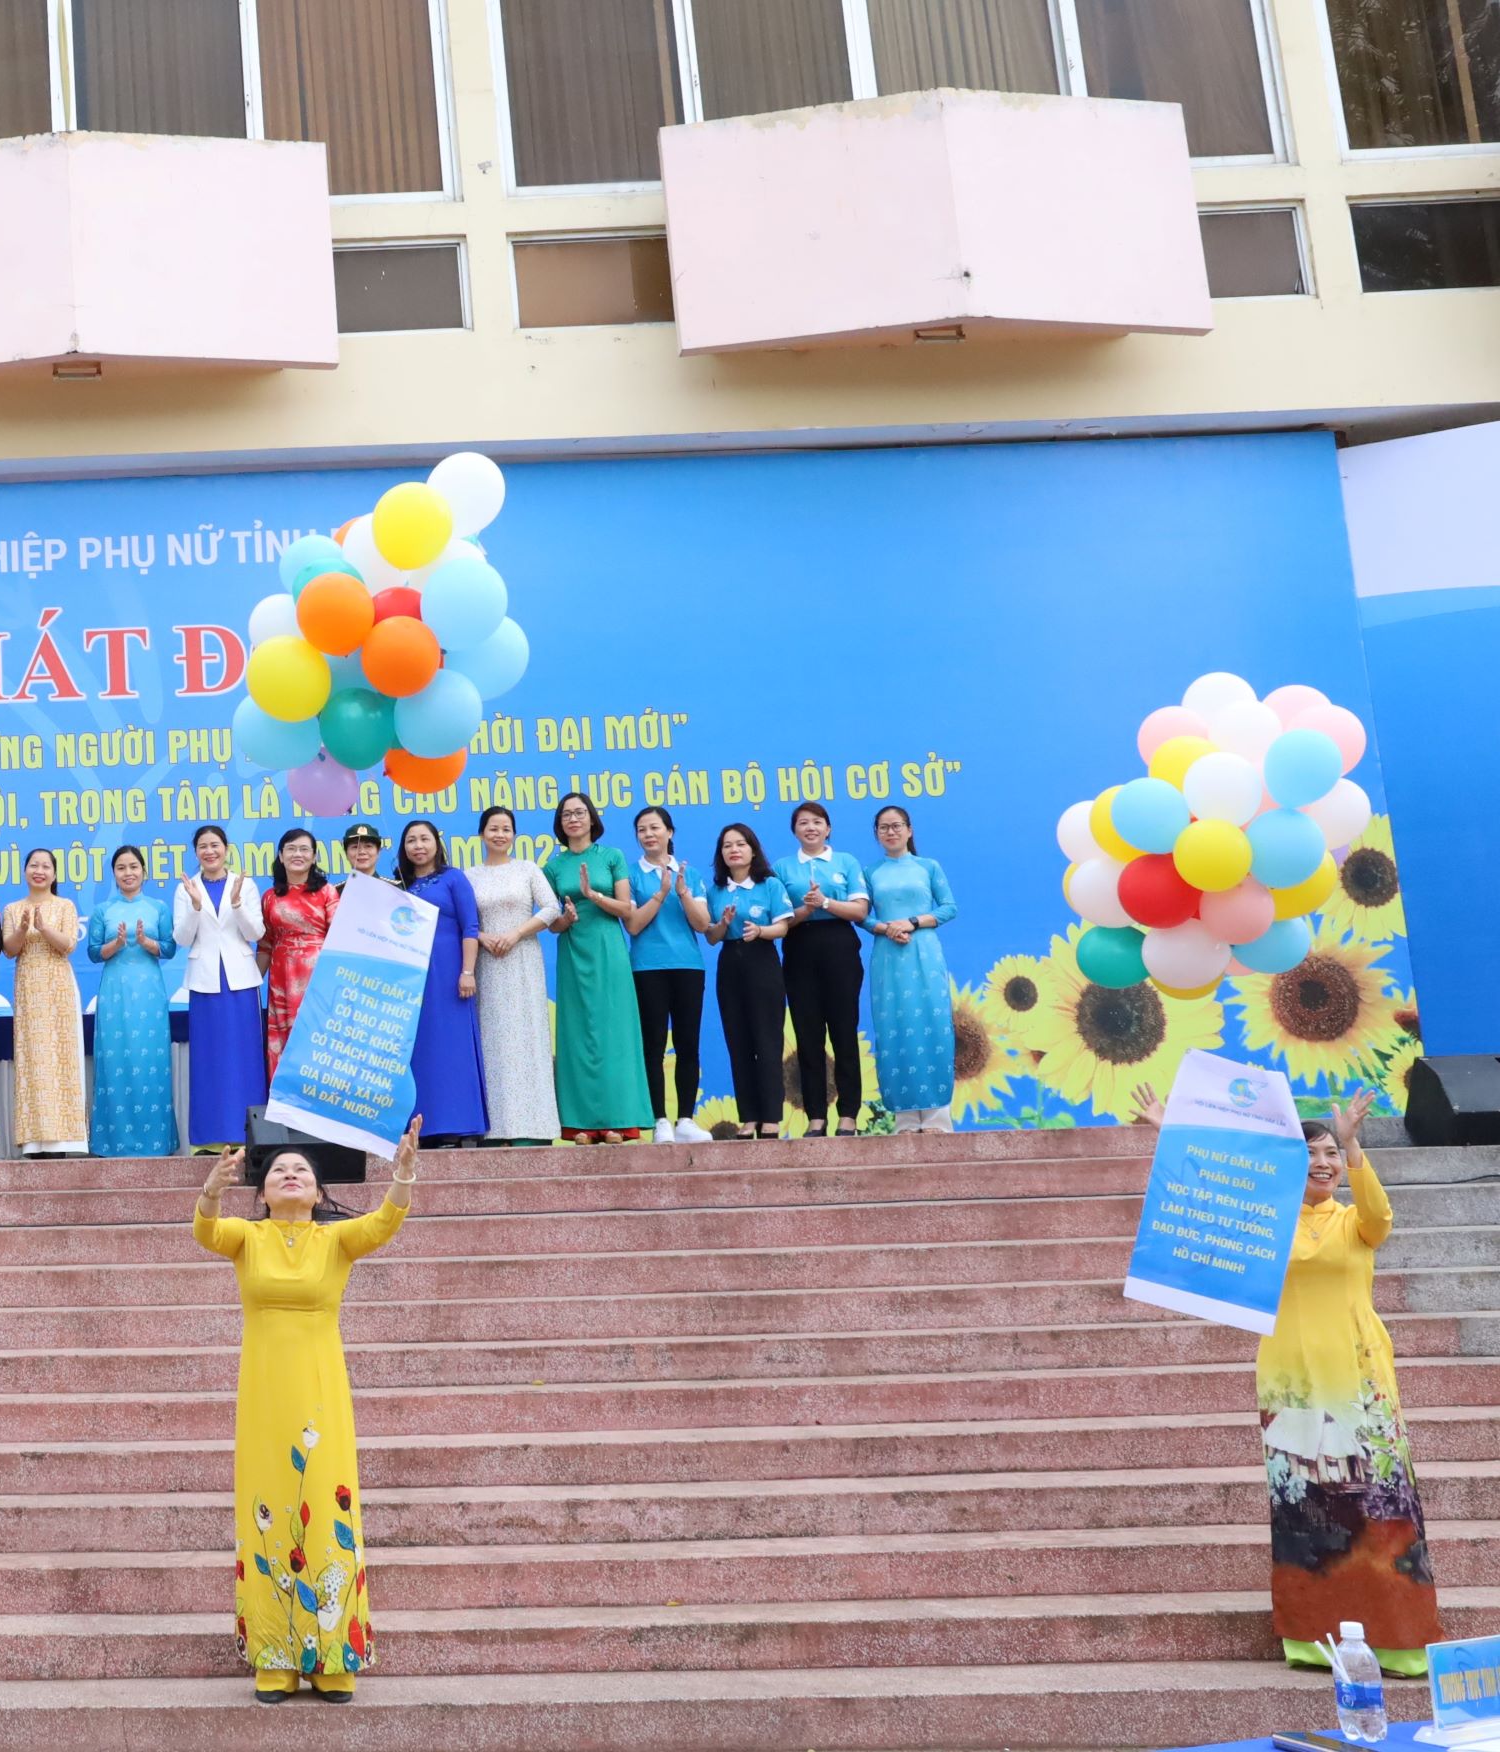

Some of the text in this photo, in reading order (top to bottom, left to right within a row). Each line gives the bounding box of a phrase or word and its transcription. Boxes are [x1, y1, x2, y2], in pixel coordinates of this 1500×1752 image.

[79, 534, 154, 576] PHỤ
[167, 523, 224, 566] NỮ
[230, 520, 316, 564] TỈN
[55, 723, 155, 768] NGƯỜI
[168, 728, 232, 770] PHỤ
[469, 711, 524, 755] HỜI
[536, 717, 593, 759] ĐẠI
[605, 707, 689, 750] MỚI”
[40, 787, 146, 832] TRỌNG
[157, 779, 231, 822] TÂM
[243, 776, 281, 818] LÀ
[469, 771, 558, 812] NĂNG
[644, 764, 710, 807] CÁN
[721, 762, 766, 811] BỘ
[845, 760, 890, 800] CƠ
[901, 751, 963, 797] SỞ”
